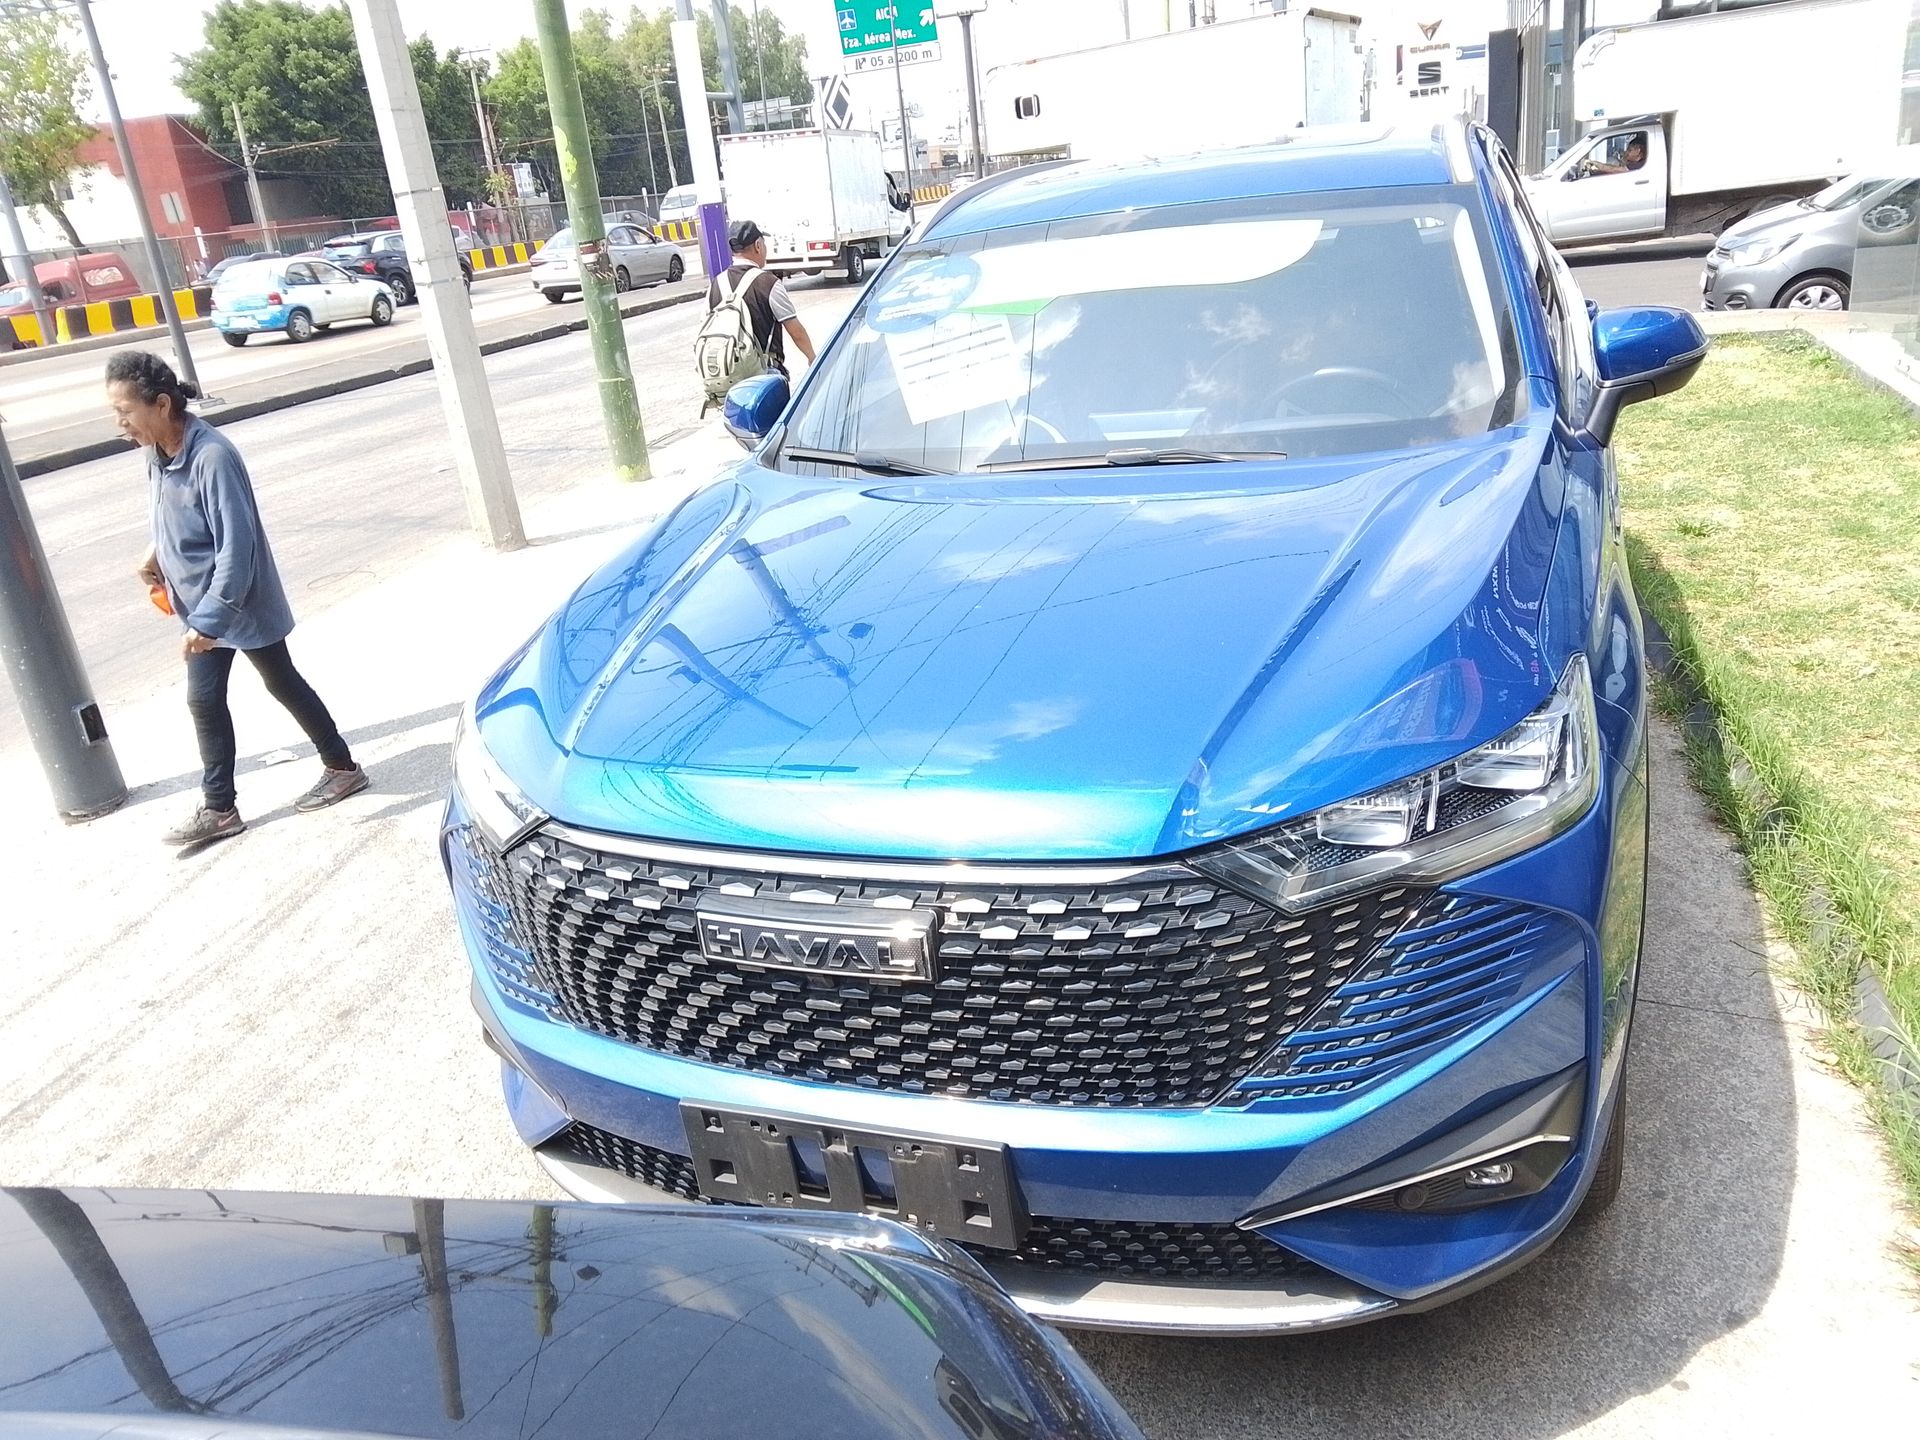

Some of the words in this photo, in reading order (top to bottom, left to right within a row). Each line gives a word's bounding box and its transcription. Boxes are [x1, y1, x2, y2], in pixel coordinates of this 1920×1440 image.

[843, 36, 862, 48] Fza.
[864, 32, 891, 46] Aérea
[895, 28, 916, 40] Mex.
[870, 56, 884, 66] 05
[897, 50, 918, 62] 200
[922, 50, 932, 58] m
[1410, 86, 1450, 98] SEAT
[707, 924, 917, 973] HAVAL
